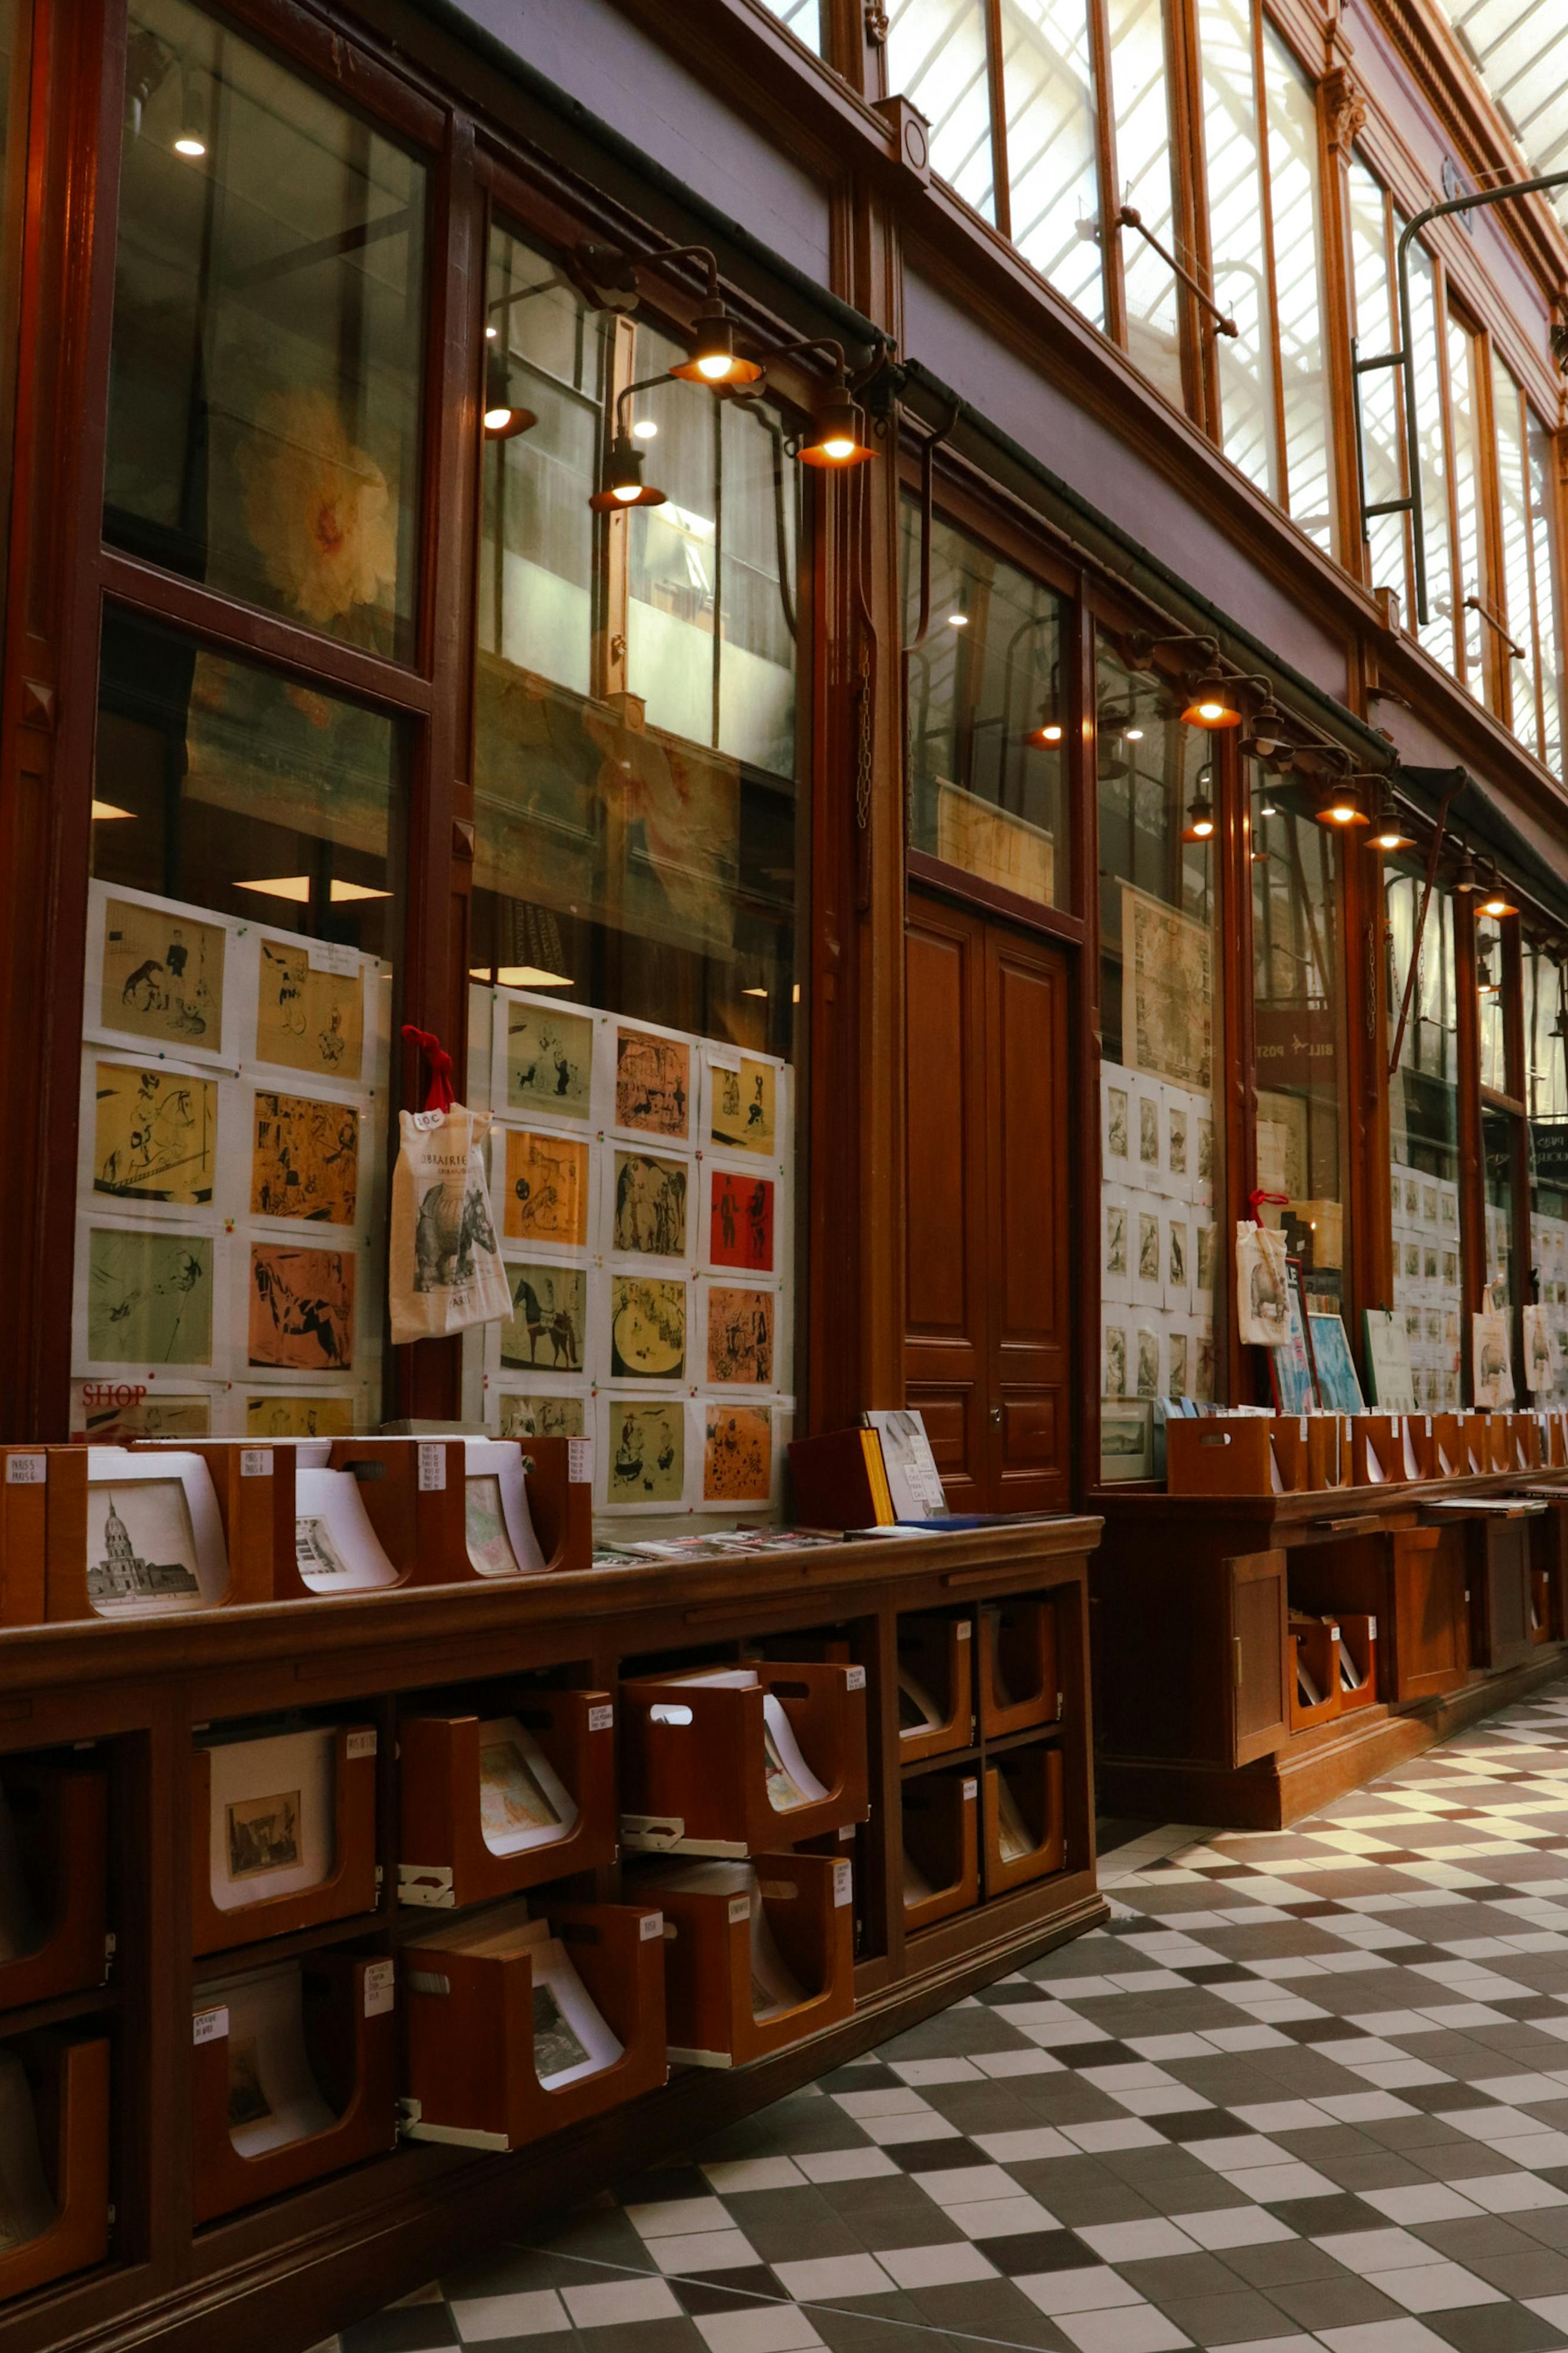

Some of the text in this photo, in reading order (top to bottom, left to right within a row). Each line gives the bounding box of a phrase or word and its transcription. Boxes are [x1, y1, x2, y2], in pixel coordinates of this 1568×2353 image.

[421, 1155, 468, 1165] IBRAIRIE
[83, 1384, 146, 1407] SHOP
[12, 1459, 29, 1470] PARIS
[12, 1472, 29, 1481] PARIS
